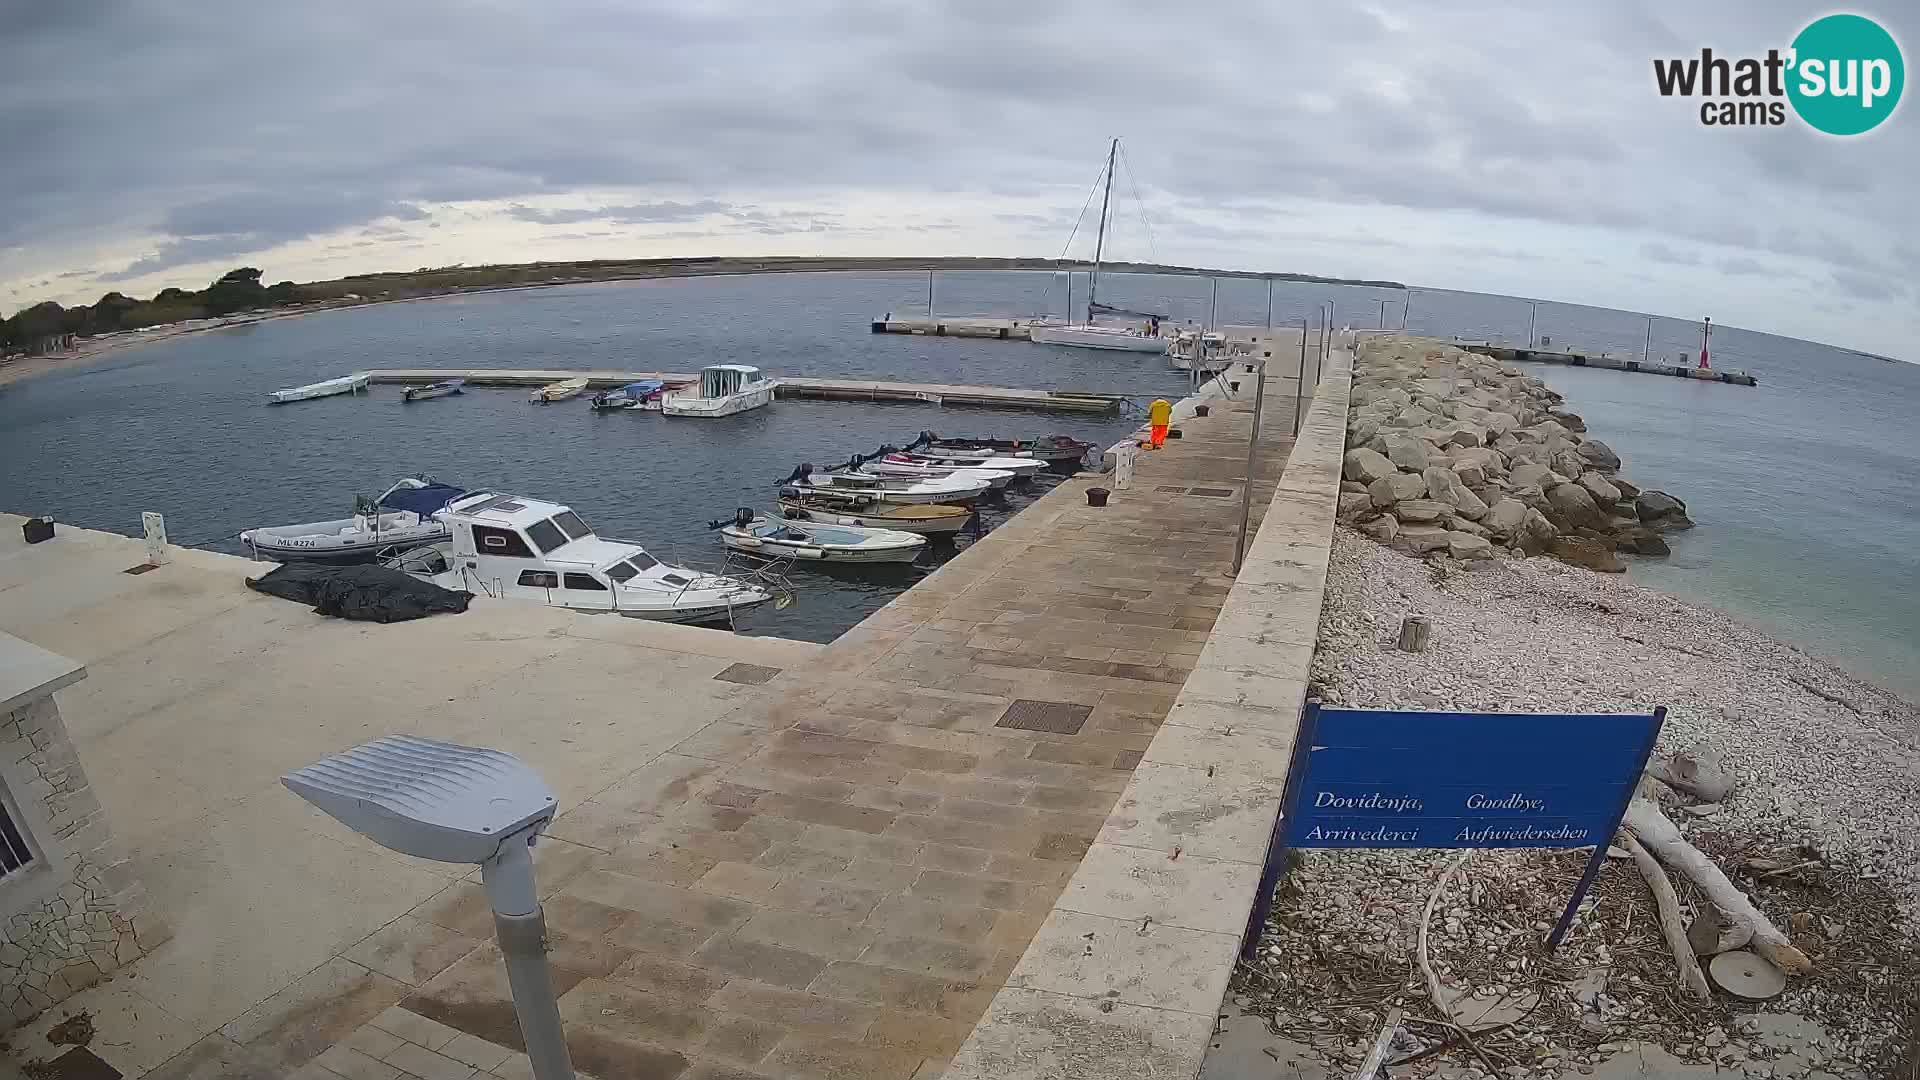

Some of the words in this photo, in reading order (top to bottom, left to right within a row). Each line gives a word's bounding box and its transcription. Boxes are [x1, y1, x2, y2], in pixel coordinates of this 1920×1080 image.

[1466, 793, 1546, 813] Goodbye,
[1304, 825, 1420, 841] Arrivederci
[1453, 824, 1589, 843] Aufwiedersehen
